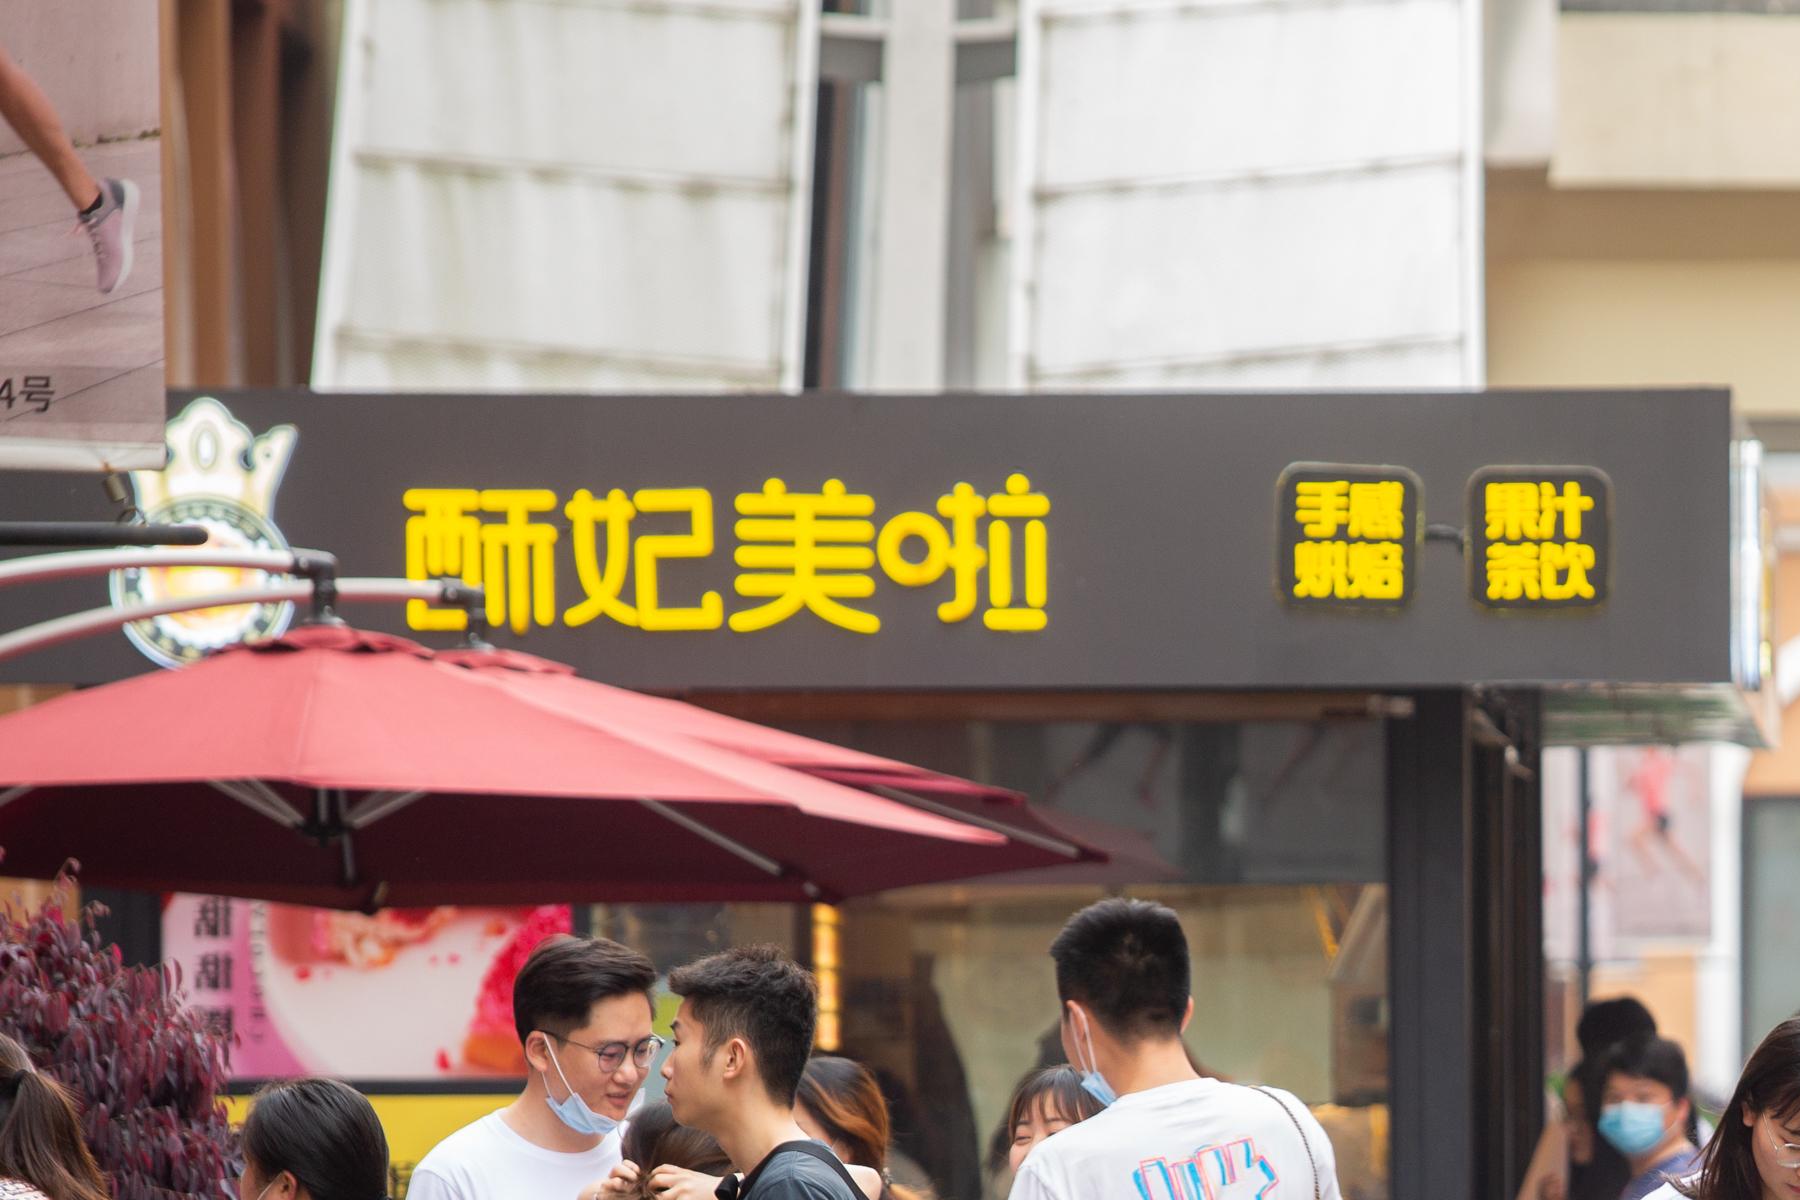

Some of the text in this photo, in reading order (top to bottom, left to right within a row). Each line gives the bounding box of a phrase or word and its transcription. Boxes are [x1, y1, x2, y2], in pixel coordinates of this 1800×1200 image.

[1295, 480, 1405, 539] 手感
[1485, 481, 1596, 540] 果汁
[1293, 540, 1405, 599] 烘焙
[1486, 541, 1596, 600] 茶饮
